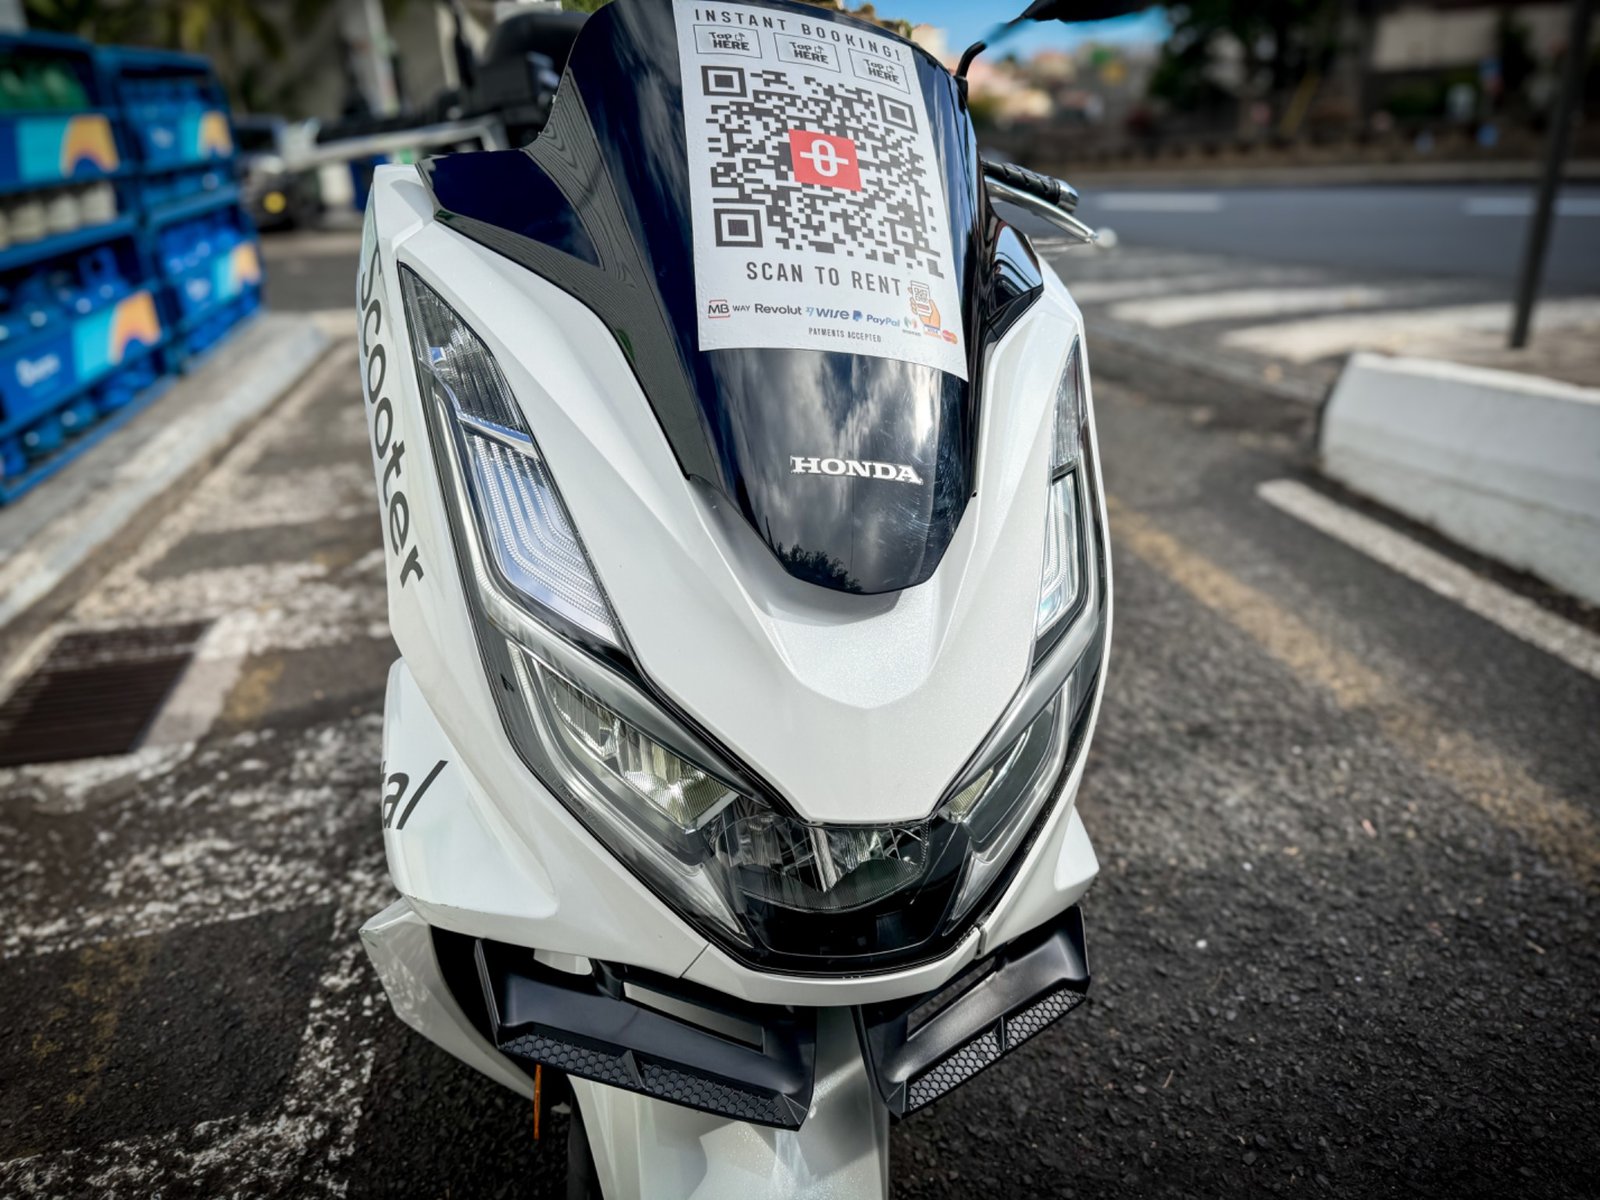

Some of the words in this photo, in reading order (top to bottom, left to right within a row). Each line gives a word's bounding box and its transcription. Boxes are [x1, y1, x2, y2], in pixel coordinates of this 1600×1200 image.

[695, 9, 786, 31] INSTANT
[708, 31, 732, 41] Tap
[713, 40, 750, 51] HERE
[789, 41, 812, 51] Tap
[794, 49, 829, 64] HERE
[863, 59, 884, 70] Tap
[868, 67, 900, 84] HERE
[746, 261, 803, 283] SCAN
[815, 265, 840, 287] TO
[852, 271, 901, 297] RENT
[708, 303, 730, 315] MB
[732, 304, 751, 312] WAY
[754, 303, 802, 316] Revolut
[866, 314, 900, 328] PayPal
[808, 327, 845, 338] PAYMENTS
[847, 331, 882, 343] ACCEPTED
[790, 455, 924, 485] HONDA
